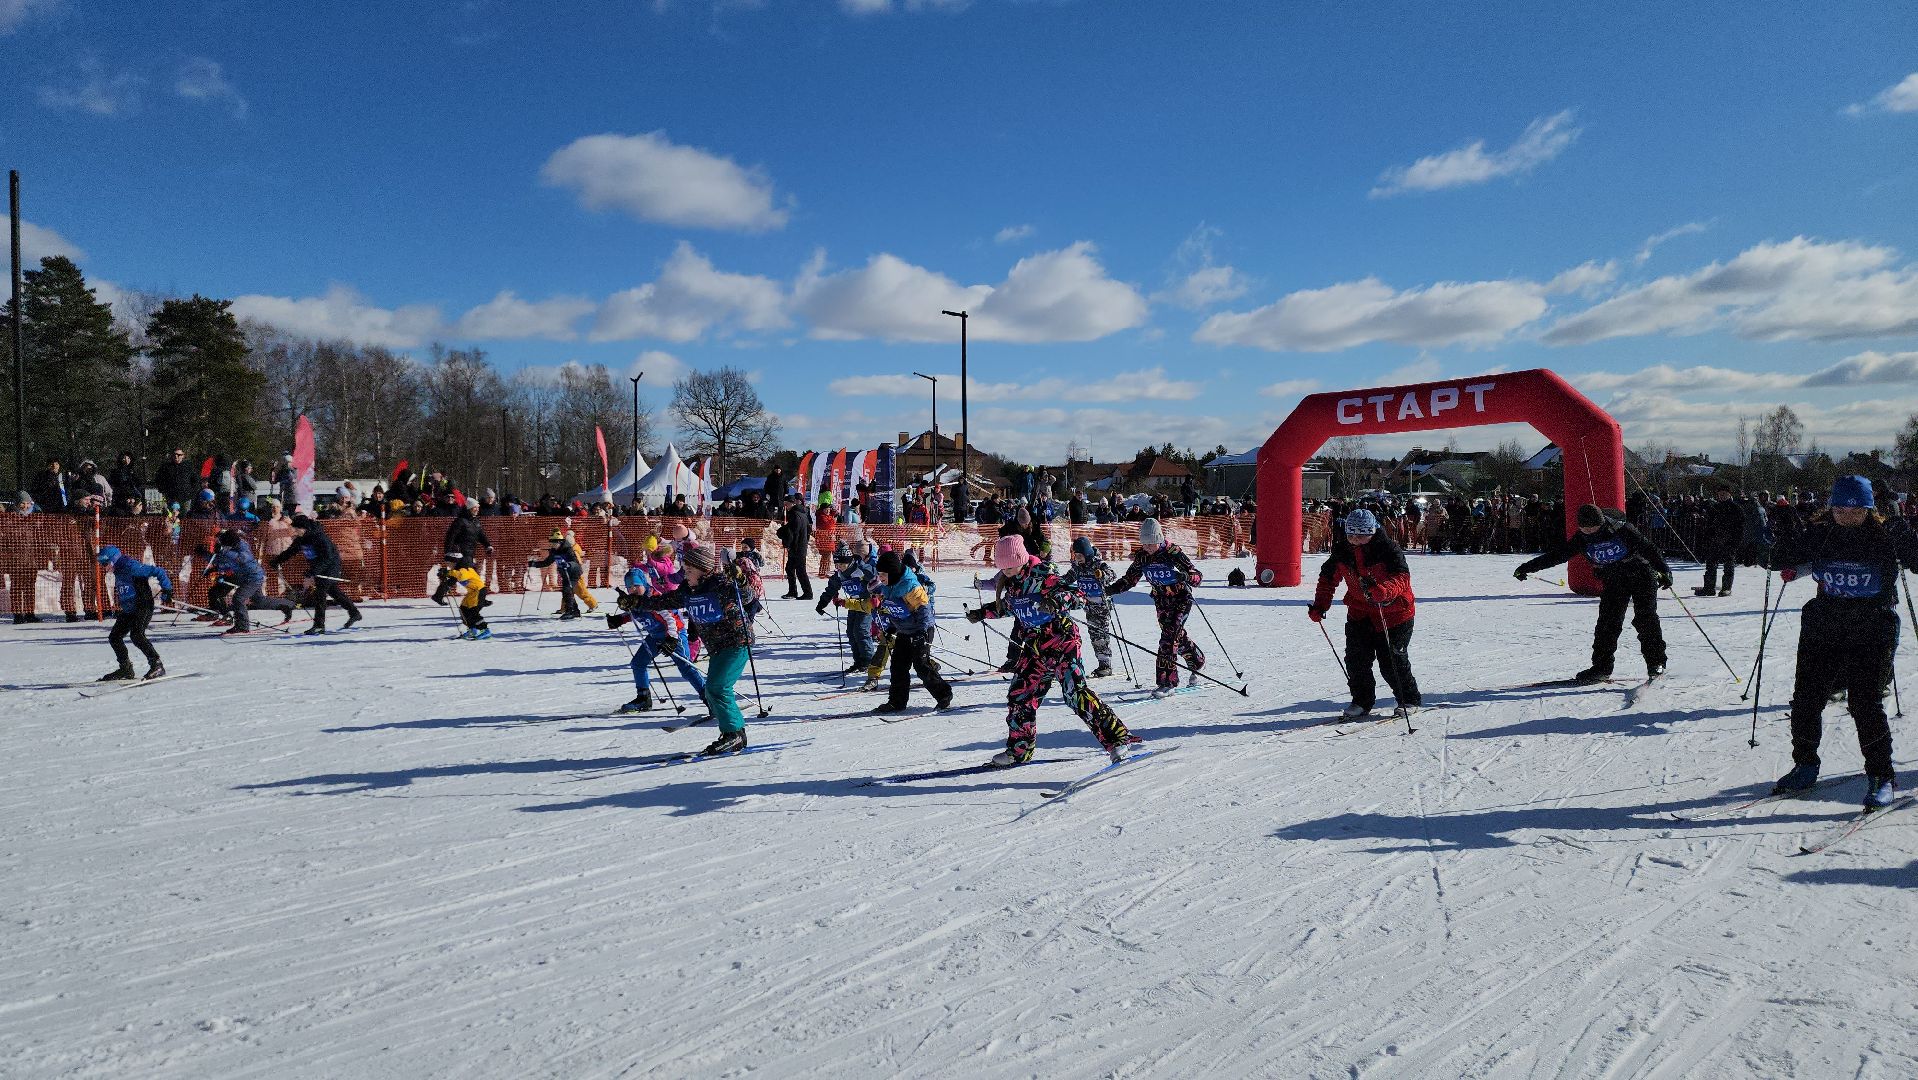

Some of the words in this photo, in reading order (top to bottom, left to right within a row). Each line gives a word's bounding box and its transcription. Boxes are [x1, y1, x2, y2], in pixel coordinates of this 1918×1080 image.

[1336, 383, 1496, 425] СТАРТ
[1146, 570, 1172, 579] 0433
[1823, 572, 1872, 587] 0387
